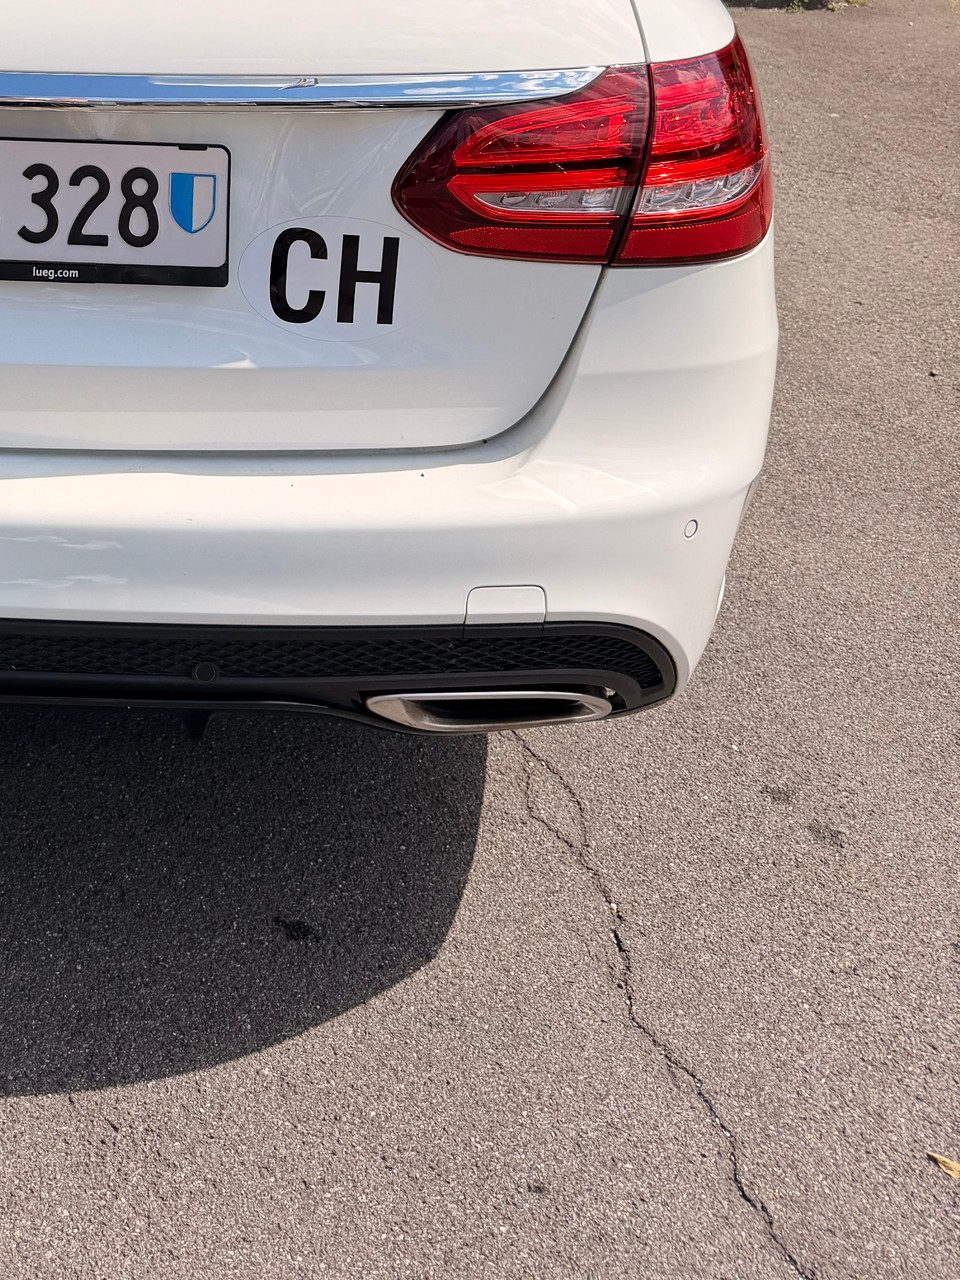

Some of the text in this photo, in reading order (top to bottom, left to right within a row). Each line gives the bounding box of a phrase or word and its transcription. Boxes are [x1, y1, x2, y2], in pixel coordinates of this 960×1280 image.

[18, 163, 159, 247] 328
[32, 266, 79, 279] lueg.com
[270, 228, 399, 324] CH
